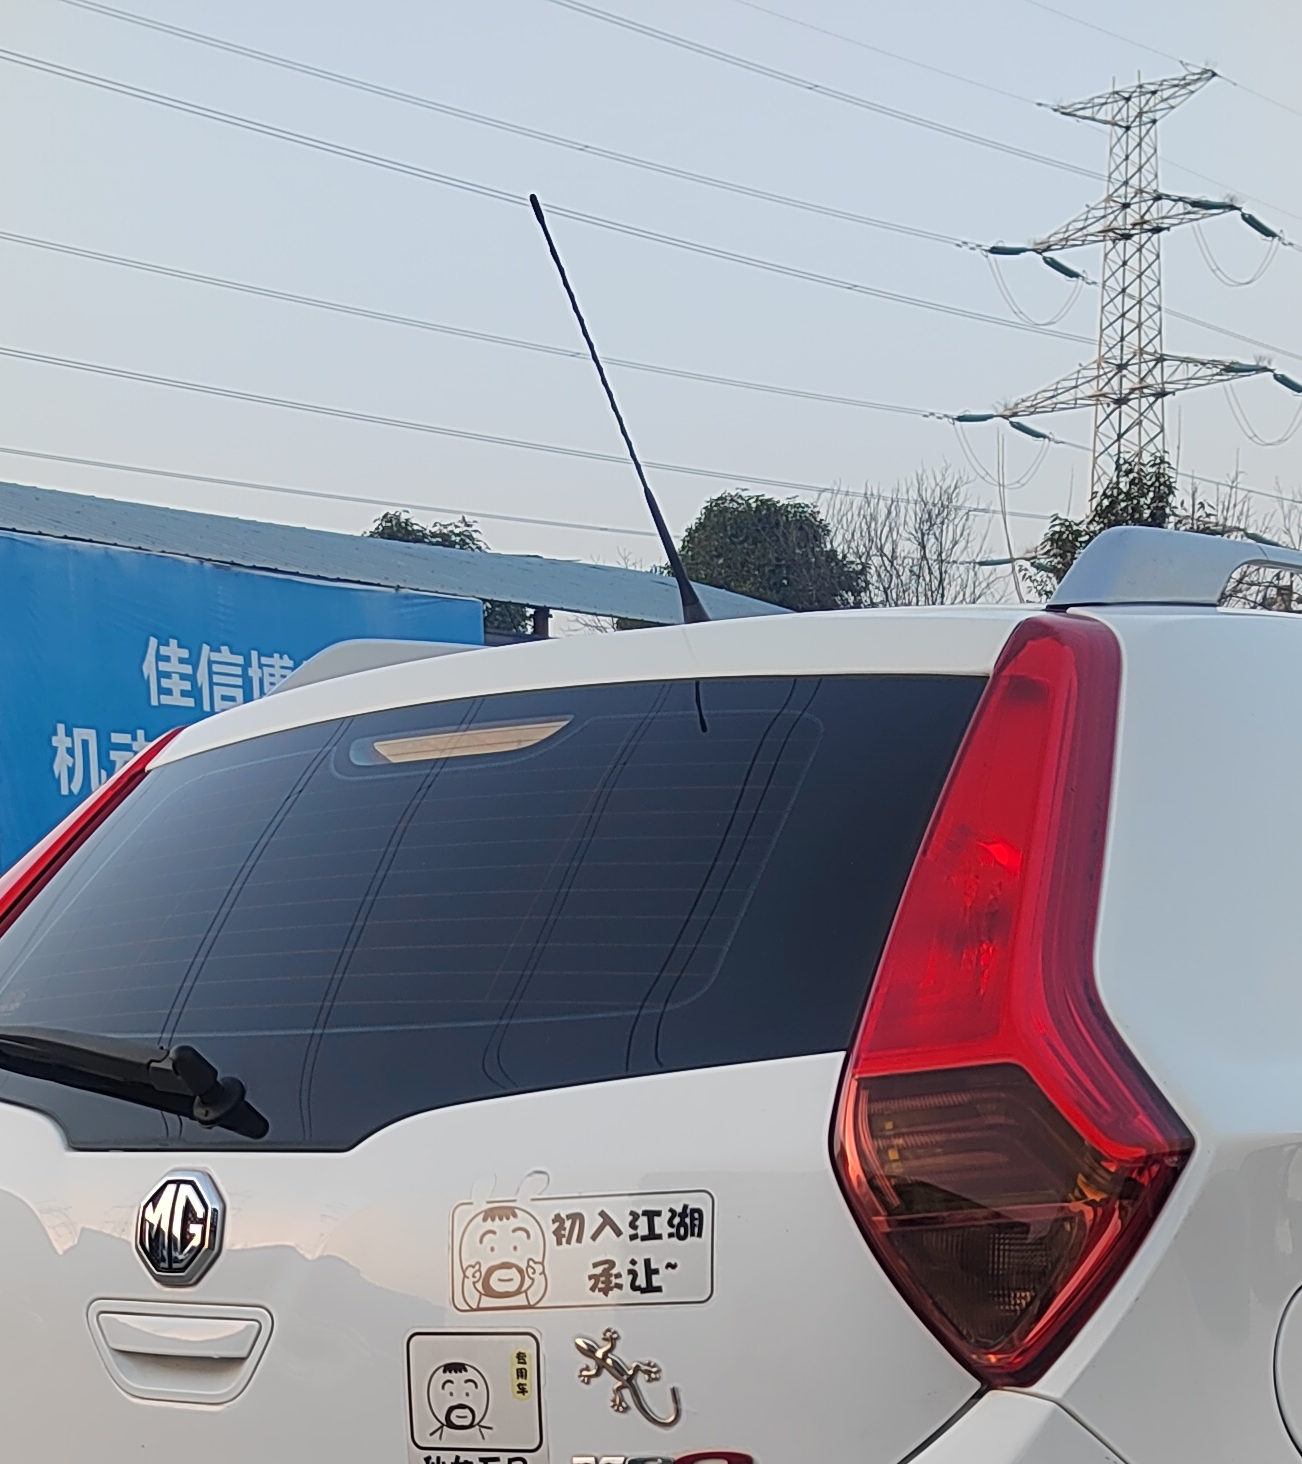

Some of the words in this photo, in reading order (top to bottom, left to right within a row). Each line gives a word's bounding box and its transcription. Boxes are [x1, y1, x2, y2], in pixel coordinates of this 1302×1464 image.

[142, 635, 306, 712] 佳信博
[142, 1179, 207, 1272] MG
[551, 1204, 704, 1246] 初入江湖
[515, 1351, 529, 1397] 专用车
